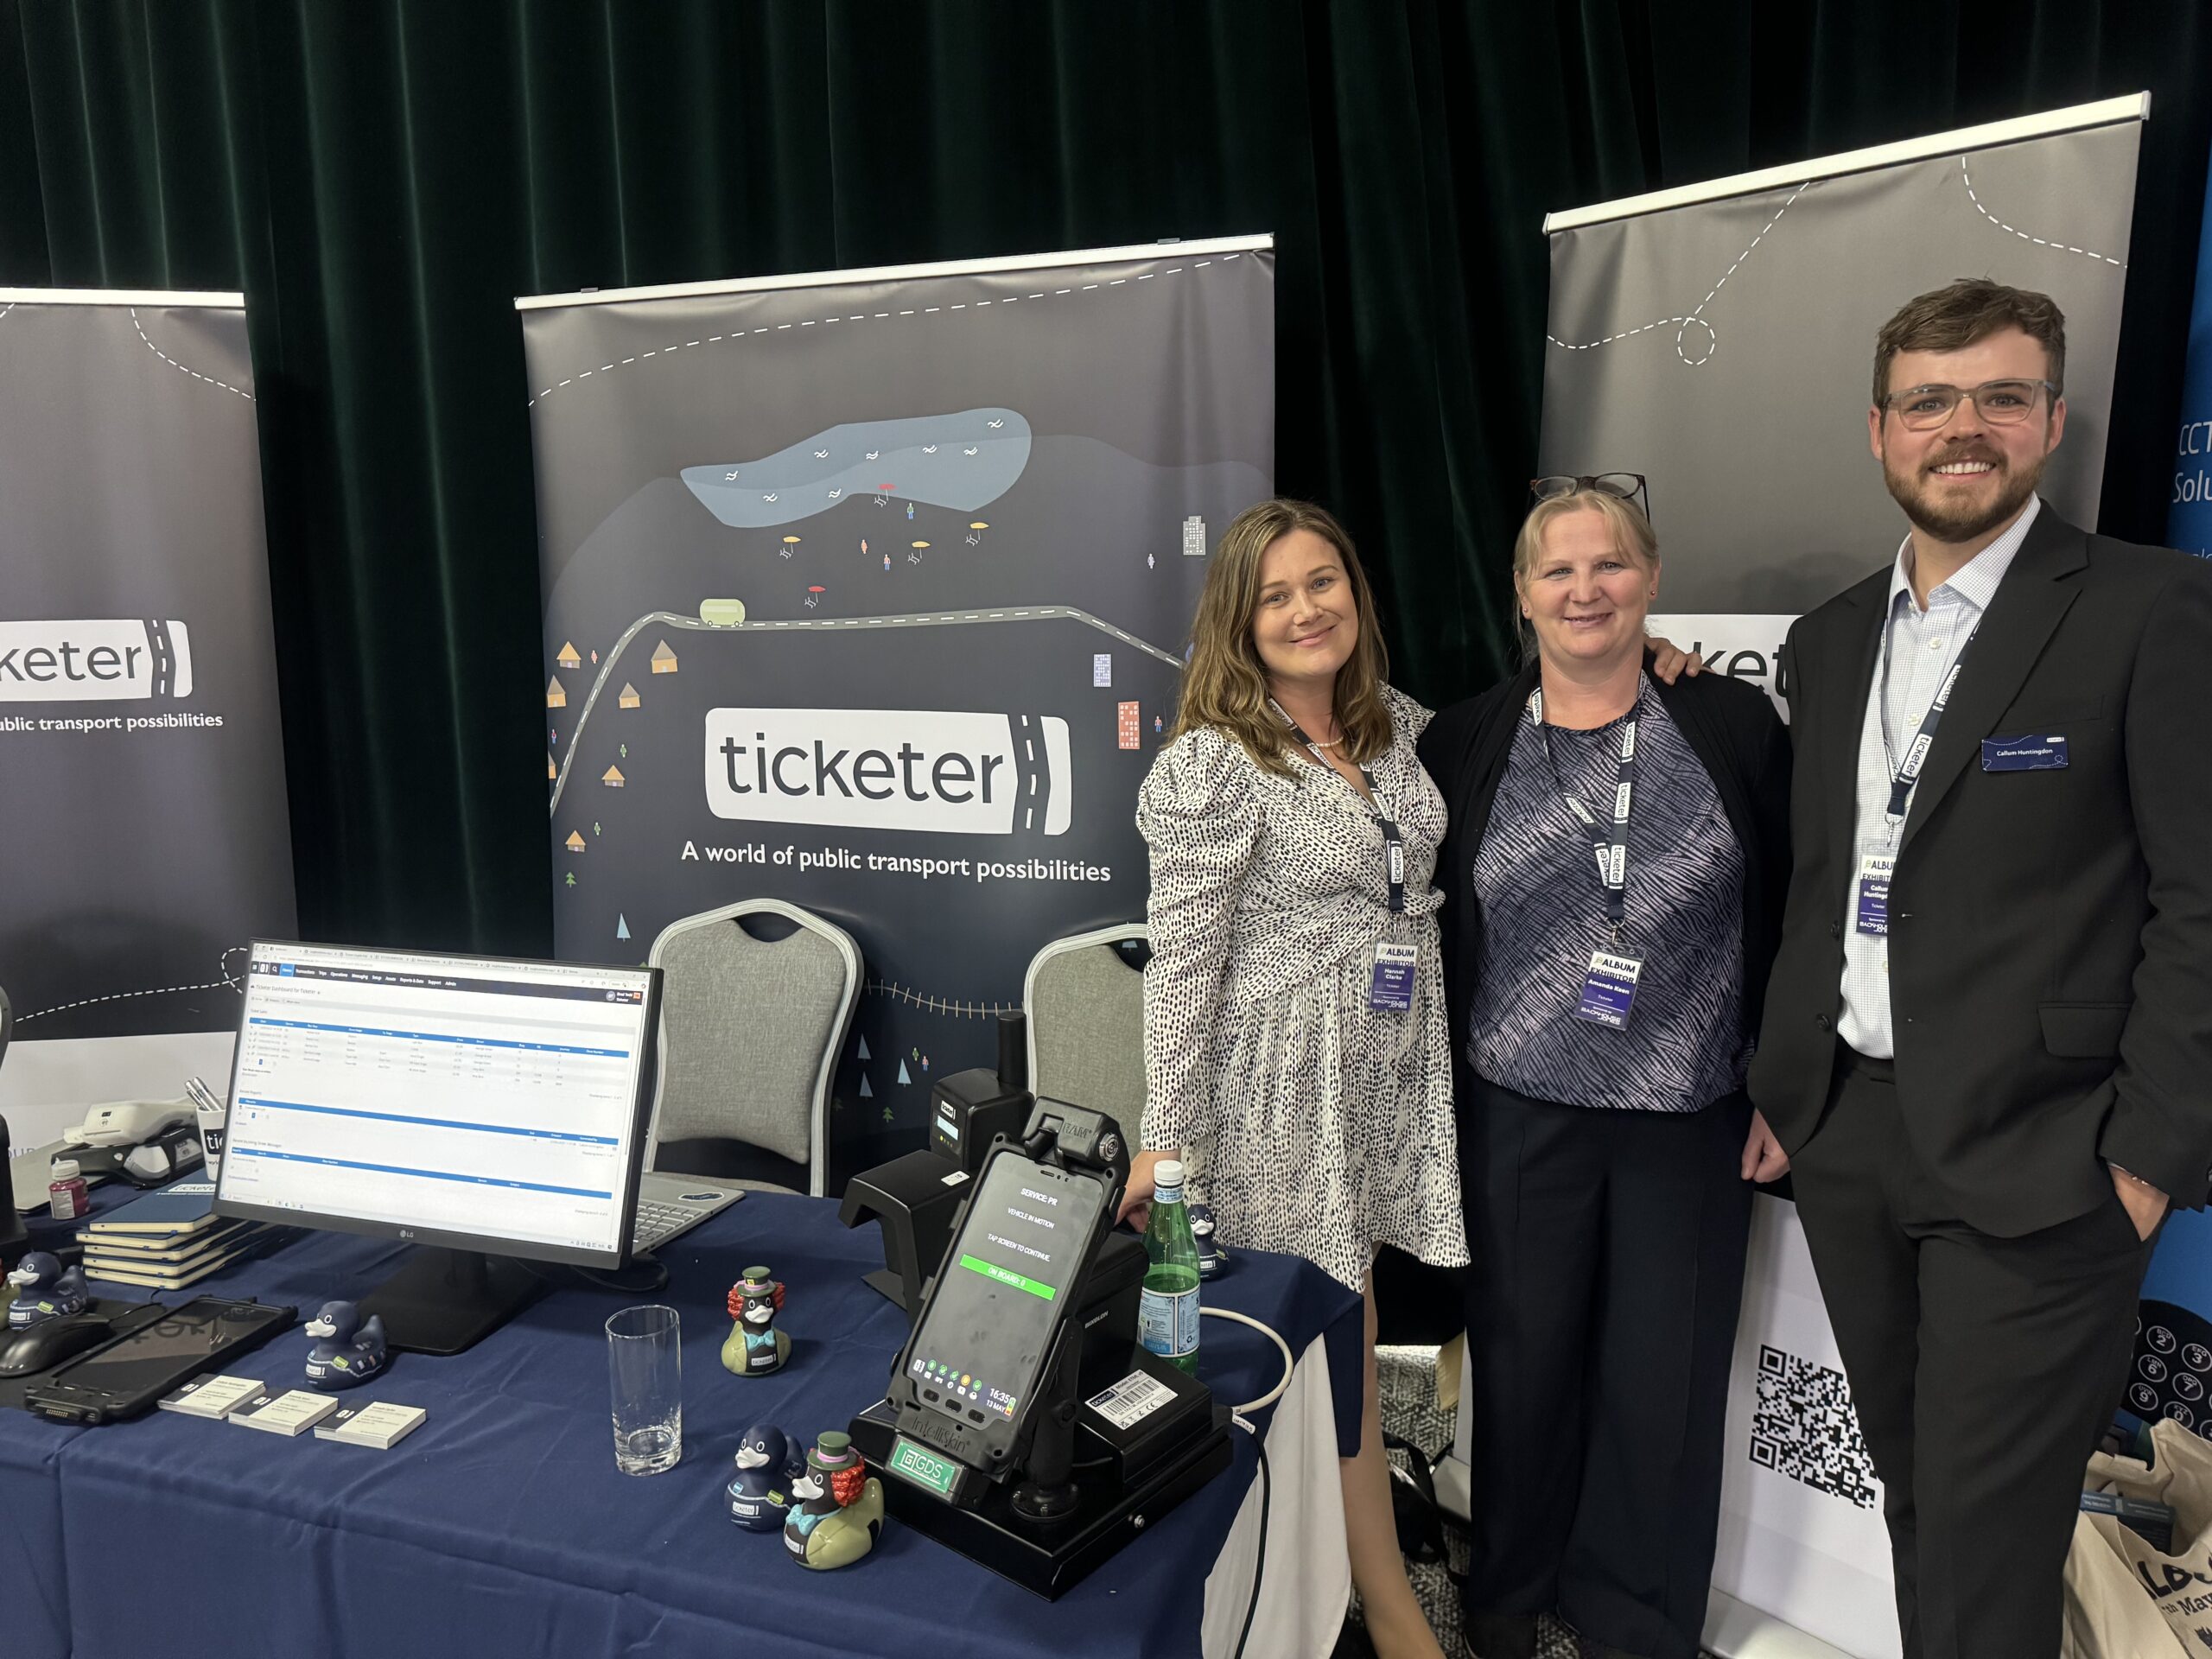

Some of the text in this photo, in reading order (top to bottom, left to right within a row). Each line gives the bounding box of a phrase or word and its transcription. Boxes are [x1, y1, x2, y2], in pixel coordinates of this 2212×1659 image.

[0, 641, 142, 682] keter
[39, 715, 123, 733] transport
[127, 713, 224, 732] possibilities
[1624, 724, 1633, 755] ticketer
[1905, 736, 1929, 776] ticketer
[720, 733, 1003, 804] ticketer
[1618, 784, 1628, 816] ticketer
[681, 841, 1111, 883] A world of public transport possibilities
[1612, 847, 1623, 881] ticketer
[1386, 948, 1414, 957] ALBUM
[1602, 958, 1636, 974] ALBUM
[1590, 967, 1635, 983] EXHIBITOR
[1588, 979, 1630, 995] Amanda Keen
[1063, 1122, 1089, 1139] RAM
[1020, 1187, 1058, 1206] SERVICE: PR
[1007, 1207, 1028, 1220] VEHICLE
[1033, 1216, 1055, 1229] MOTION
[988, 1233, 998, 1243] TAP
[997, 1236, 1017, 1249] SCREEN
[1016, 1243, 1025, 1252] TO
[988, 1267, 997, 1275] ON
[997, 1269, 1020, 1284] BOARD:
[1084, 1310, 1109, 1329] BIXOLON
[2156, 1335, 2167, 1347] 2
[2146, 1357, 2162, 1368] LMN
[2192, 1352, 2202, 1363] 3
[2148, 1363, 2158, 1375] 6
[2183, 1381, 2195, 1392] 7
[990, 1388, 1010, 1403] 16:35
[2139, 1391, 2149, 1402] 9
[986, 1399, 1007, 1413] 13 MAY
[2174, 1410, 2184, 1421] 0
[916, 1456, 944, 1478] GDS
